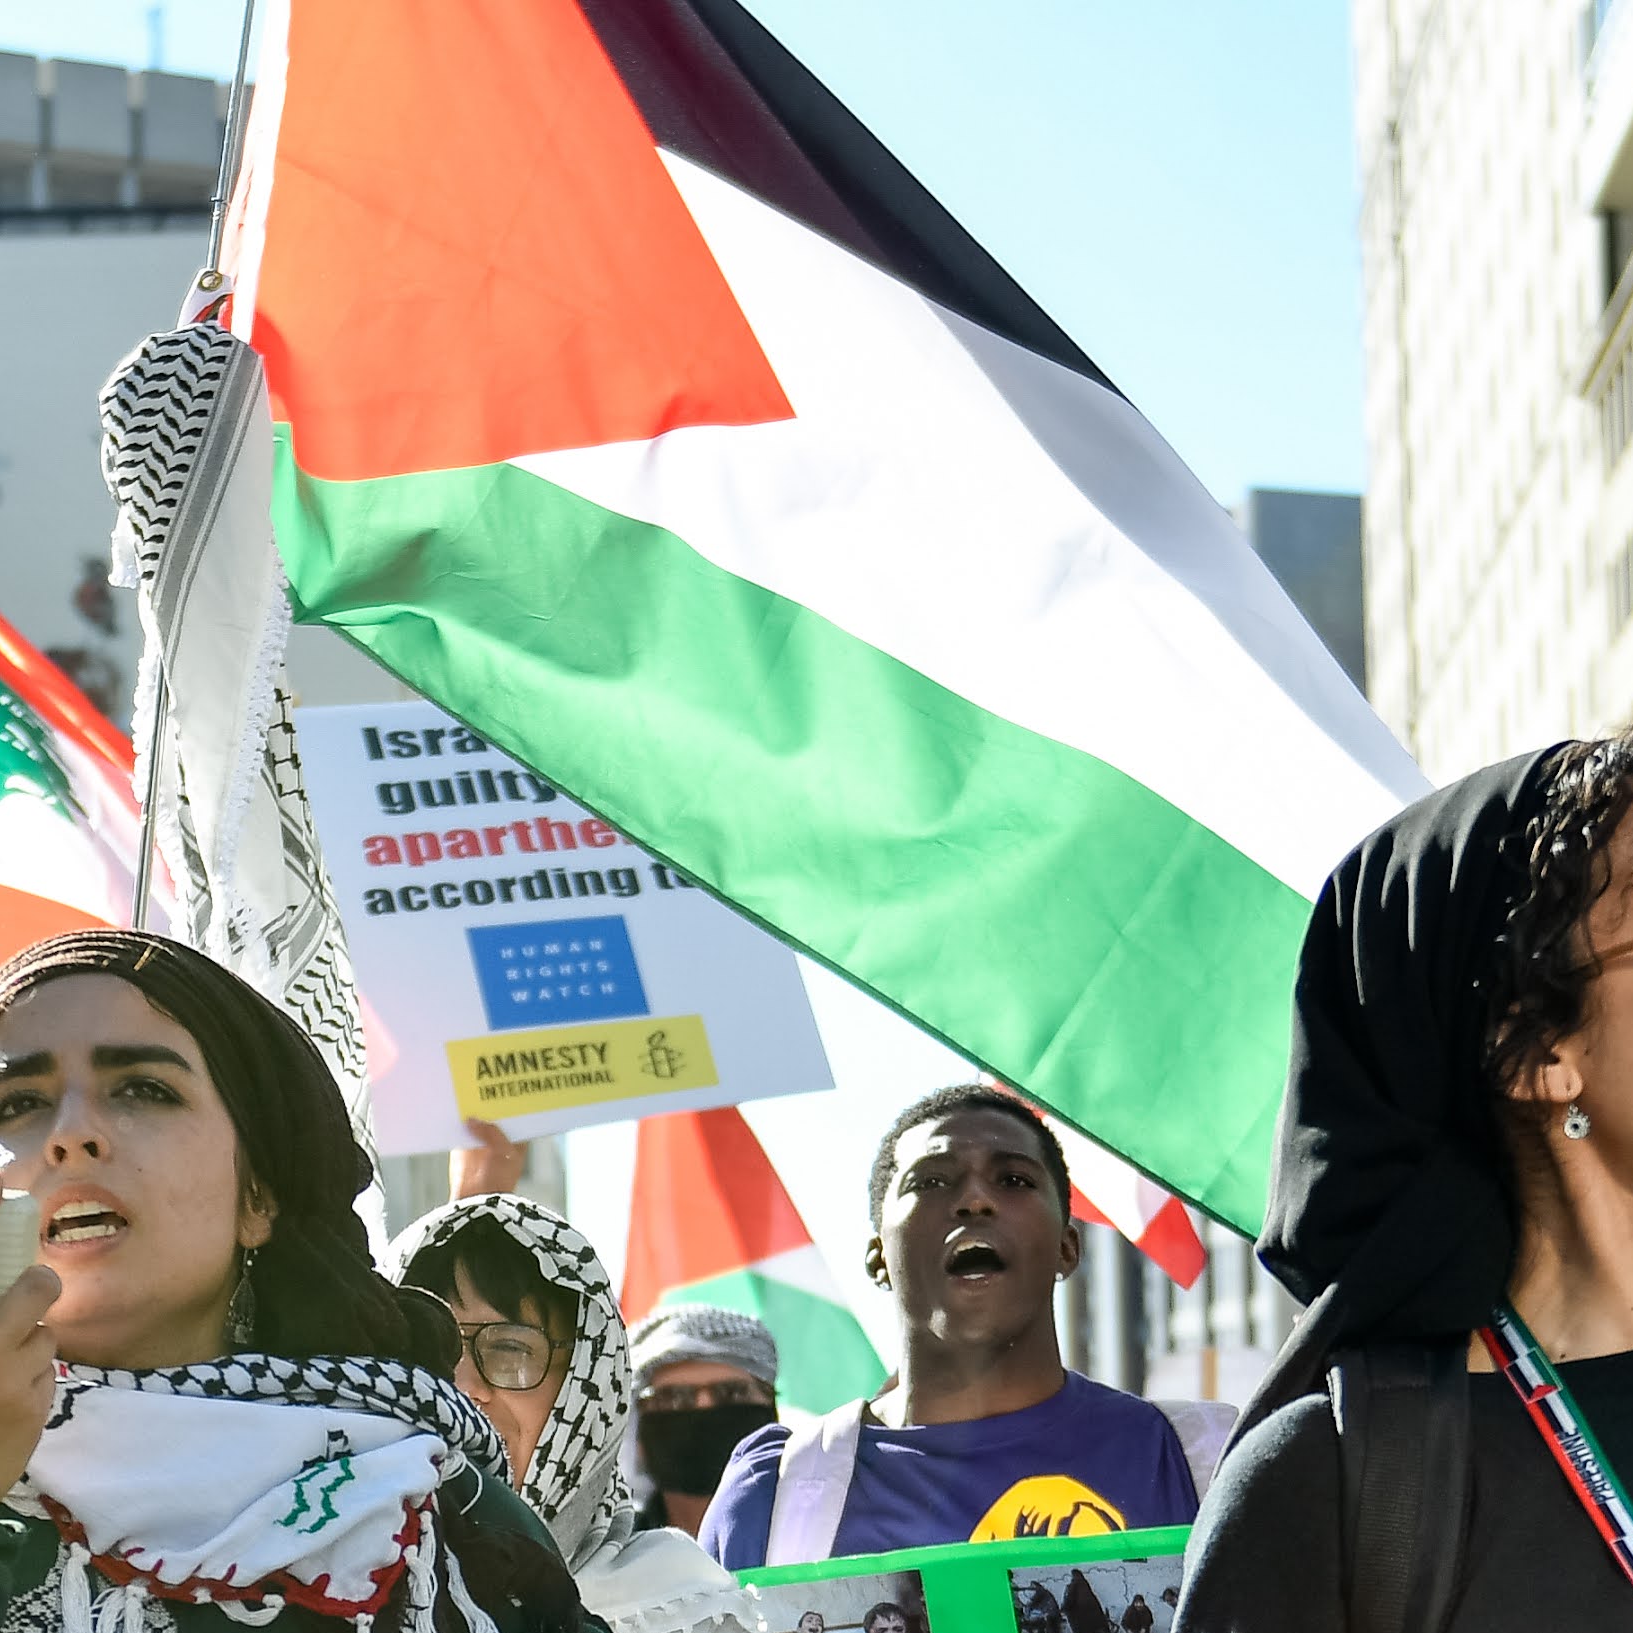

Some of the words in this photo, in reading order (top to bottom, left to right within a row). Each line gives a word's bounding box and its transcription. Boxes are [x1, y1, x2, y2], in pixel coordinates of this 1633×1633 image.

[364, 726, 488, 760] Isra
[375, 768, 557, 816] guilty
[363, 815, 633, 867] aparthe
[364, 866, 641, 916] according
[501, 939, 605, 960] HUMAN
[505, 960, 609, 981] RIGHTS
[511, 982, 615, 1002] WATCH
[475, 1041, 608, 1080] AMNESTY
[479, 1070, 615, 1101] INTERNATIONAL
